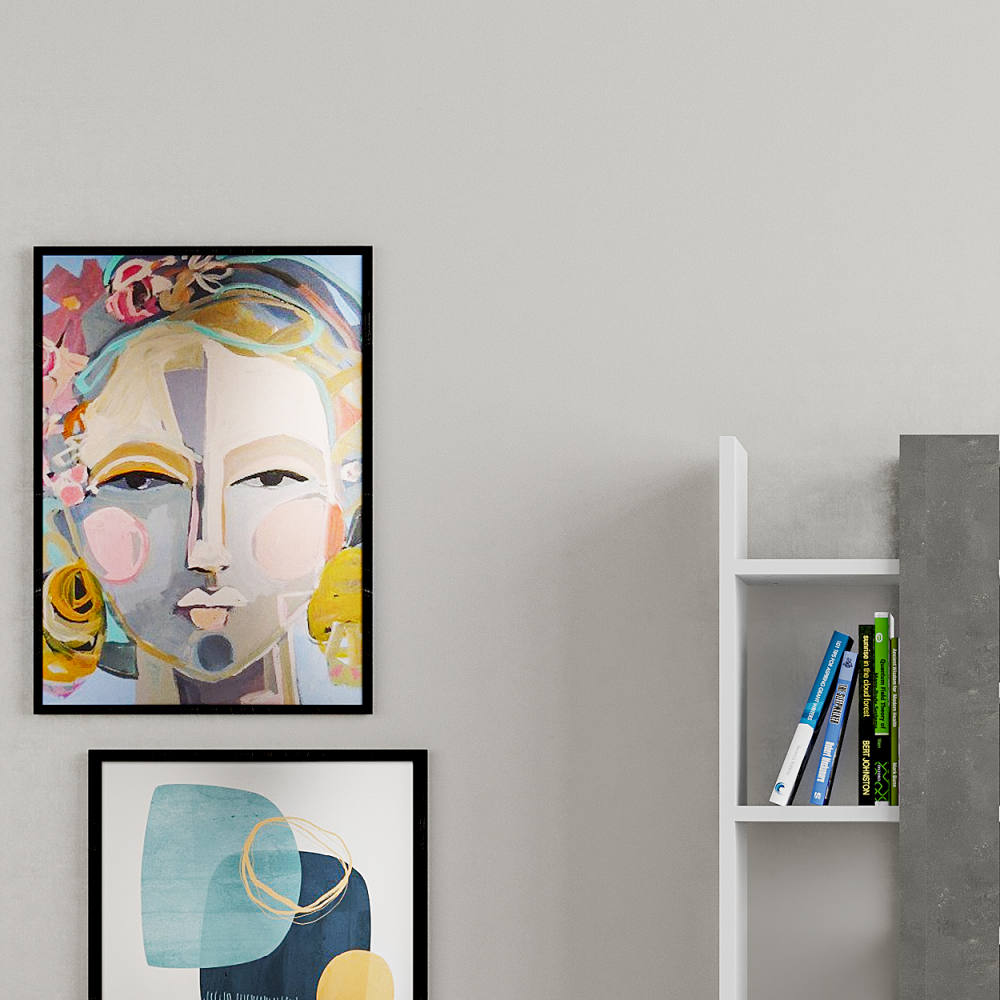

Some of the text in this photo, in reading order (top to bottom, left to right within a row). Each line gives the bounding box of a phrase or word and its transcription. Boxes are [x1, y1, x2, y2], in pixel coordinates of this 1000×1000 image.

[831, 649, 839, 658] TIPS
[863, 697, 871, 717] forest
[862, 739, 870, 795] BERT JOHNSTON
